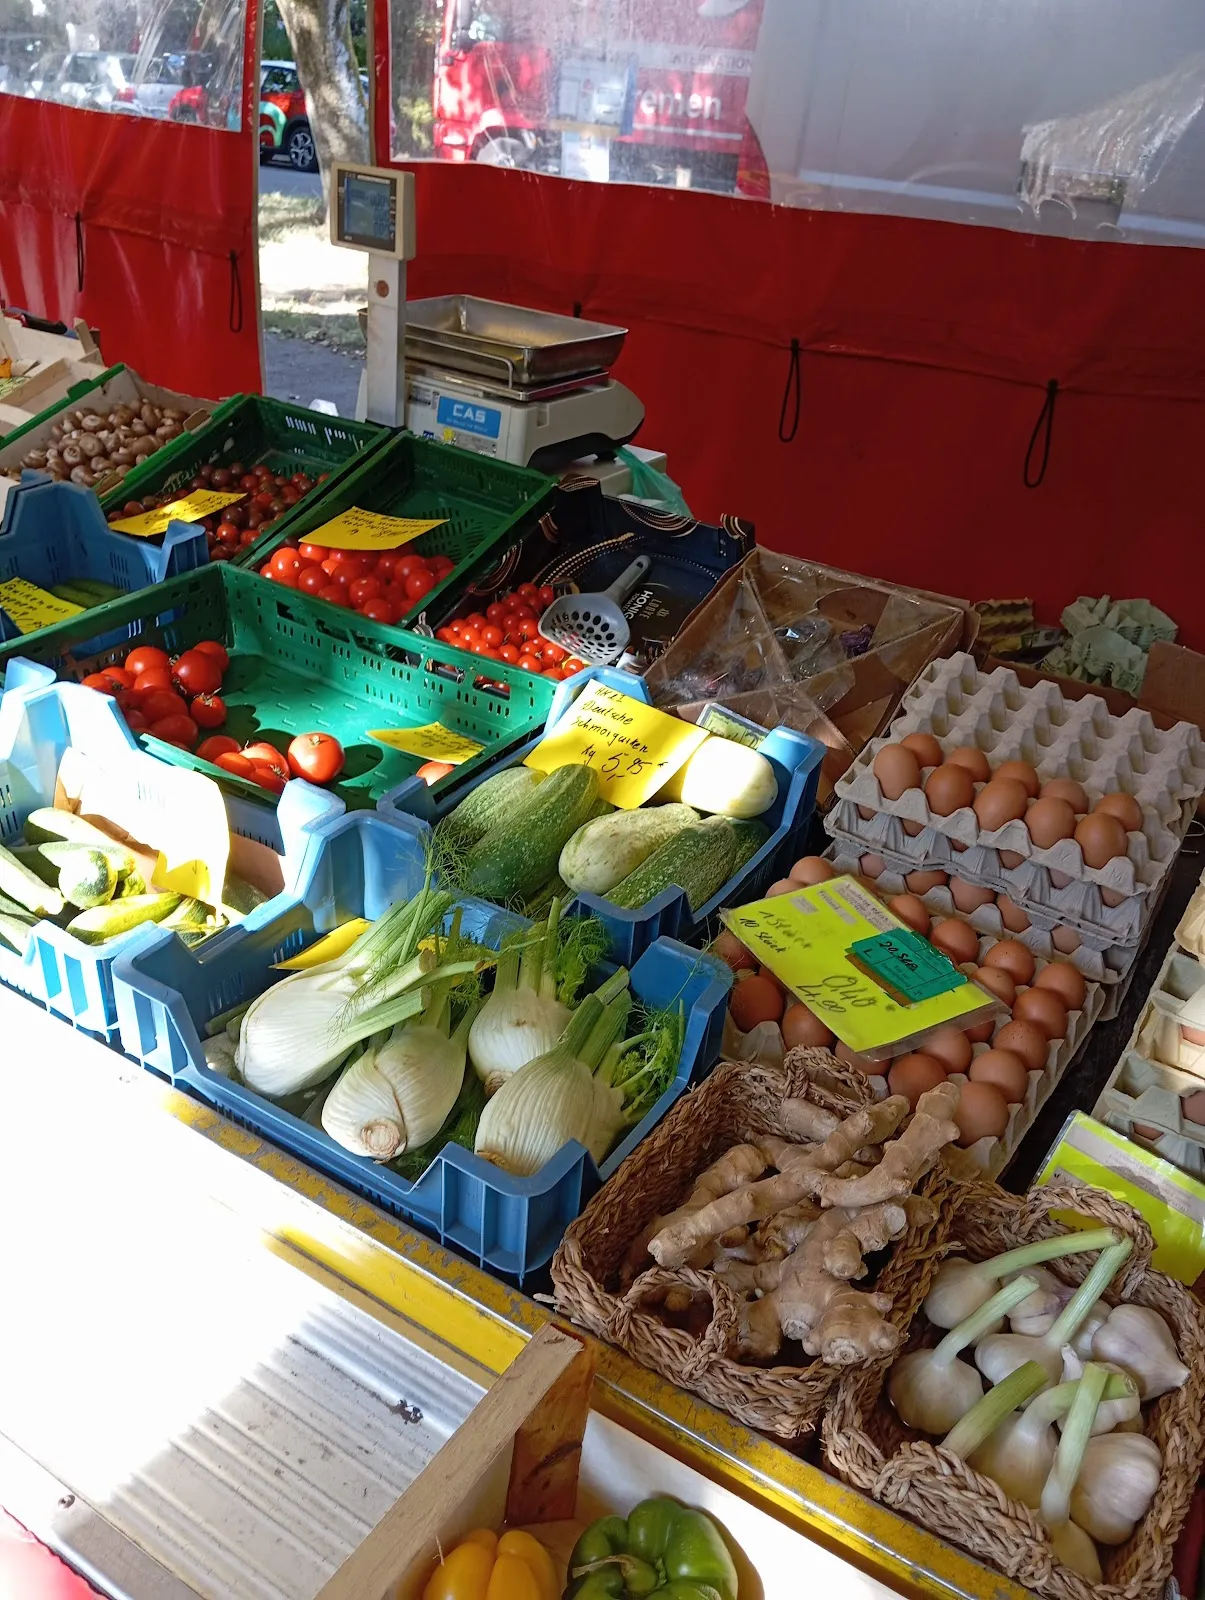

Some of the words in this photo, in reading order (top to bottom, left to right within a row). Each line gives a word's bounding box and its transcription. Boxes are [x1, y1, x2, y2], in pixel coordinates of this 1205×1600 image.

[452, 403, 486, 424] CAS
[582, 699, 634, 725] Deutsche
[738, 917, 760, 929] 10
